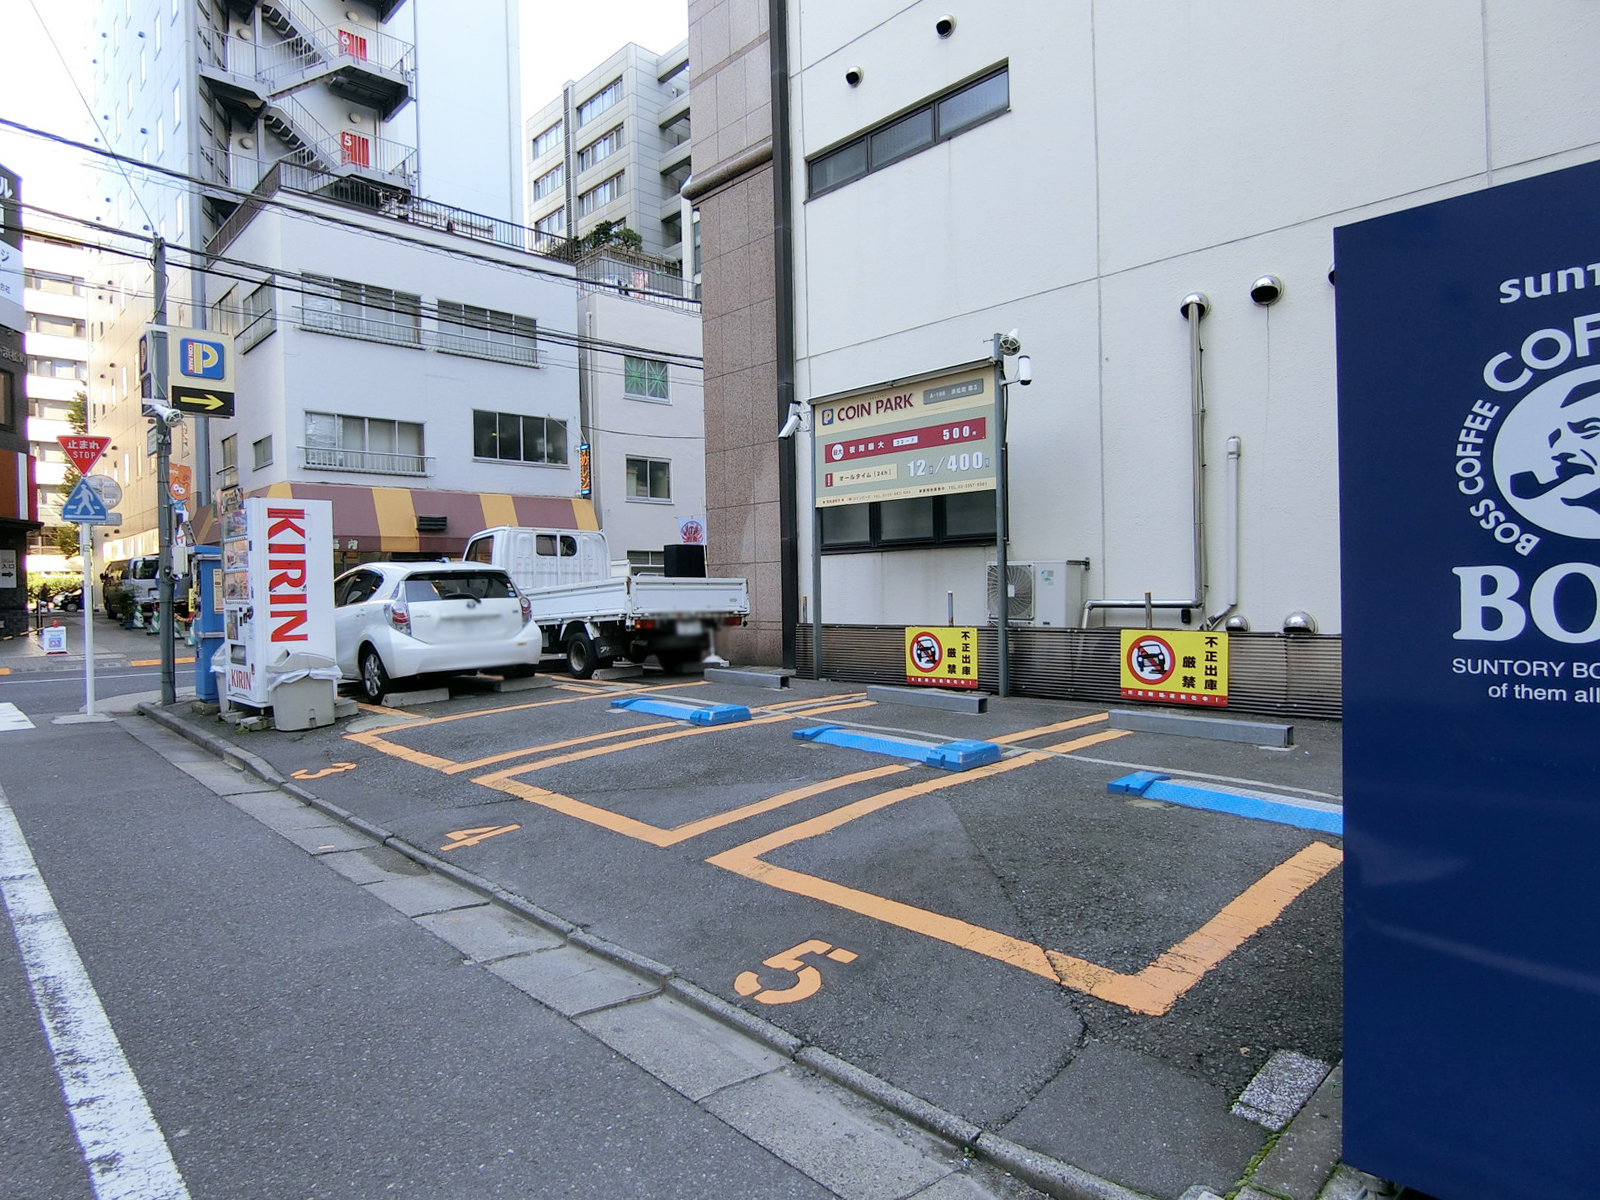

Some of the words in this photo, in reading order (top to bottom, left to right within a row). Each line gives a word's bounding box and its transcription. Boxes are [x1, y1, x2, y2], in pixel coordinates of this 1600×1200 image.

[341, 34, 350, 46] 6
[344, 135, 352, 146] 5
[837, 402, 871, 421] COIN
[875, 393, 914, 415] PARK
[67, 440, 100, 449] 止まれ
[73, 451, 96, 459] STOP
[1455, 400, 1500, 495] COFFEE
[1470, 498, 1540, 556] BOSS
[267, 508, 308, 642] KIRIN
[947, 648, 957, 675] 厳禁
[961, 631, 970, 675] 不正出庫
[1204, 637, 1218, 690] 不正出庫
[231, 669, 252, 690] KIRIN
[1182, 656, 1195, 689] 厳禁
[1452, 658, 1565, 677] SUNTORY
[1488, 682, 1508, 698] of
[1513, 684, 1567, 702] them
[290, 762, 357, 780] 3
[441, 824, 521, 851] 4
[734, 939, 859, 1005] 5
